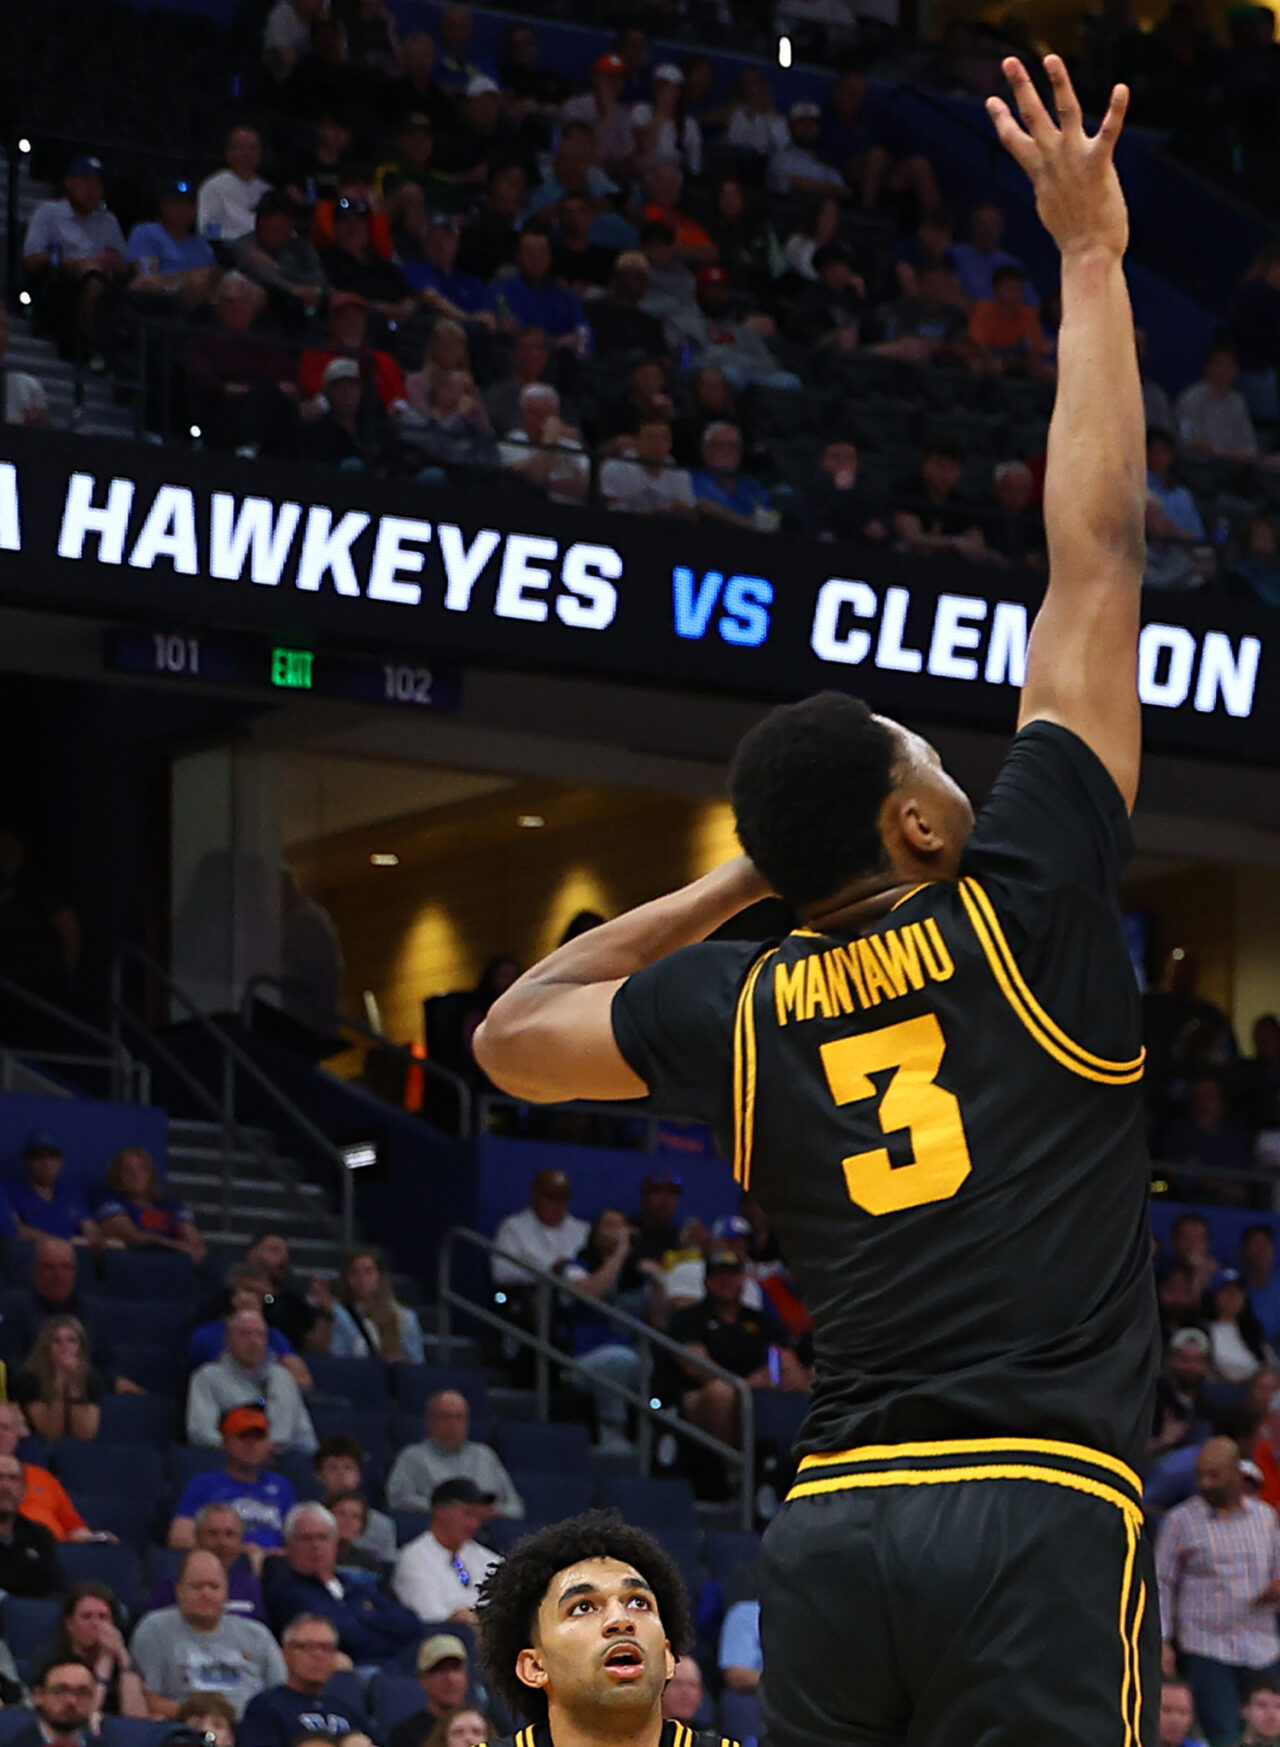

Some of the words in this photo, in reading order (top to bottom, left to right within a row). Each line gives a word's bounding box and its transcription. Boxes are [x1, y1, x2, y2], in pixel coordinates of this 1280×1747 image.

[57, 472, 623, 630] HAWKEYES
[672, 566, 775, 647] VS
[811, 578, 1263, 718] CLEMON
[154, 632, 199, 674] 101
[383, 664, 433, 705] 102
[773, 917, 956, 1027] MANYAWU
[818, 1012, 973, 1216] 3
